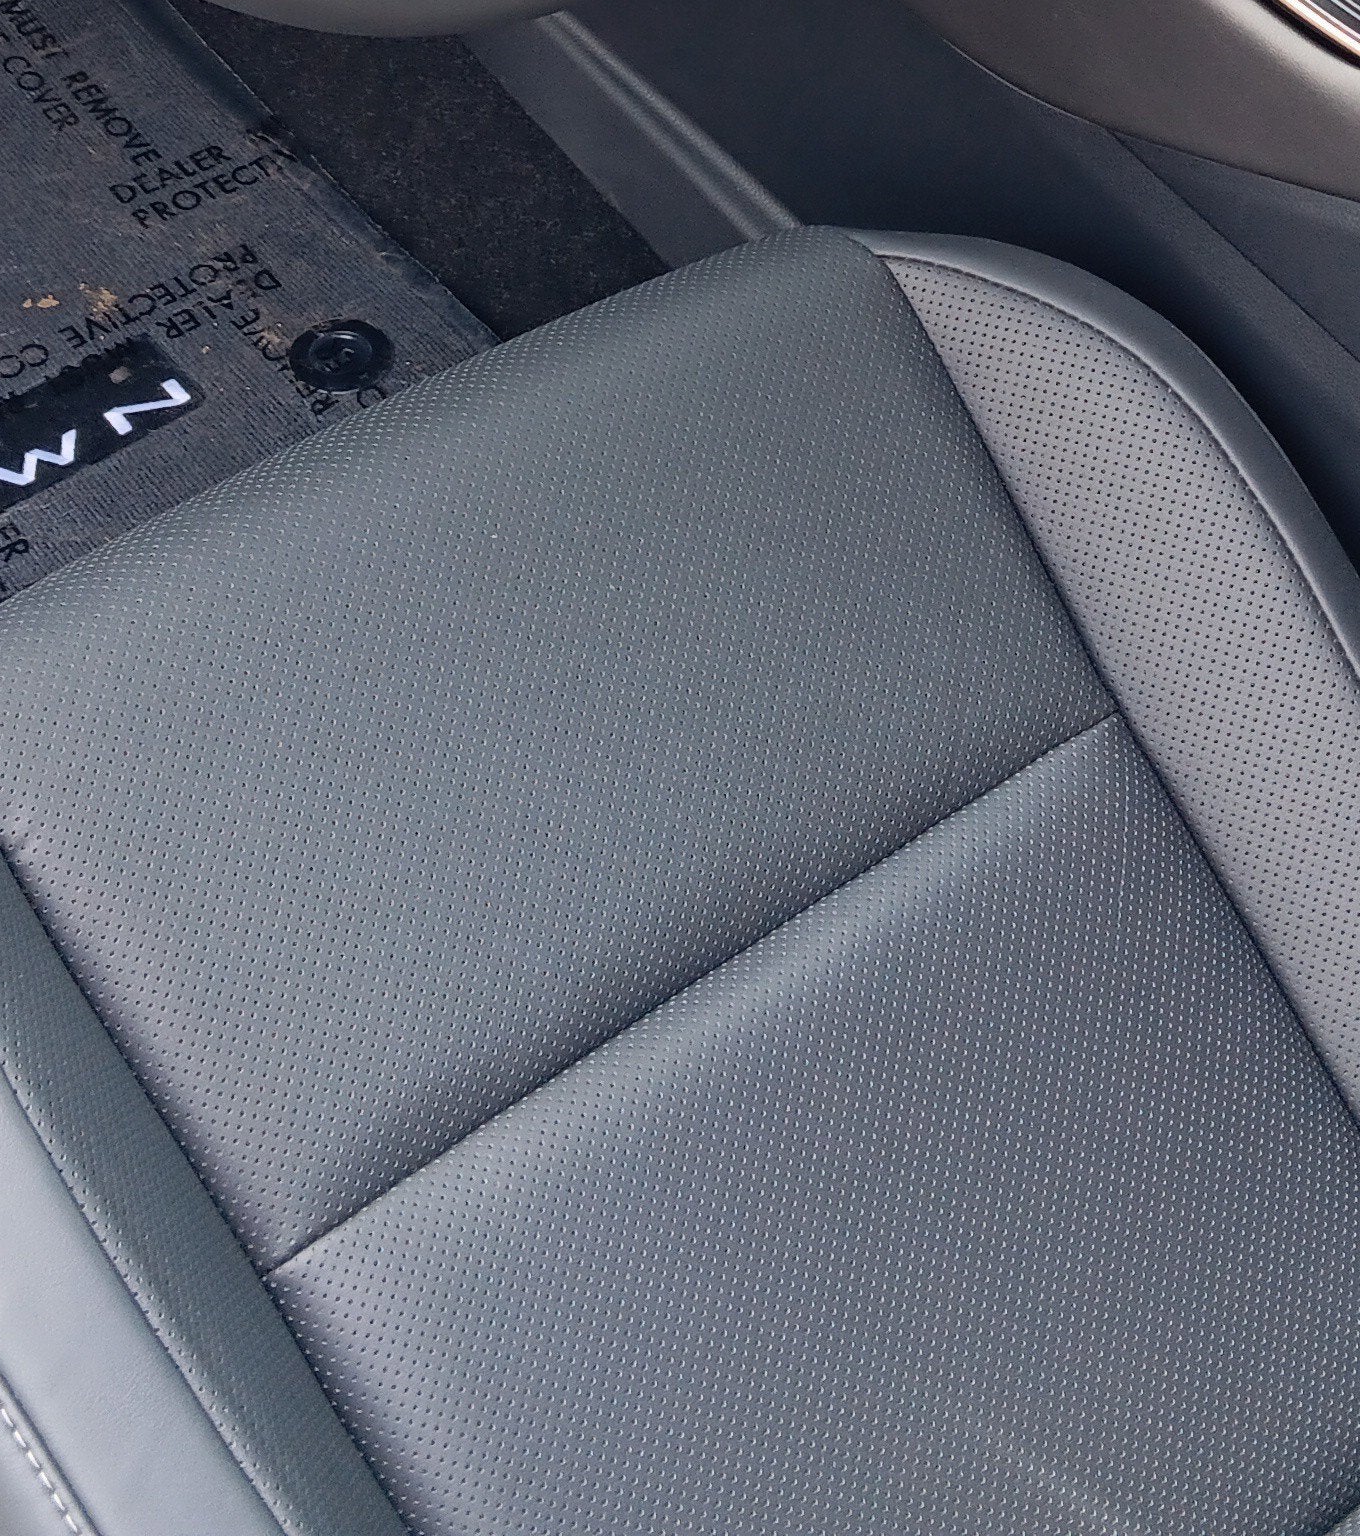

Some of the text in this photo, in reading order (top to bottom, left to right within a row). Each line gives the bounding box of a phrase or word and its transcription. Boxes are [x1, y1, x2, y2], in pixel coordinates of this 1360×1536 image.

[2, 55, 81, 132] COVER
[62, 69, 164, 167] REMOVE
[109, 145, 233, 204] DEALER
[58, 244, 258, 349] PROTECTIVE
